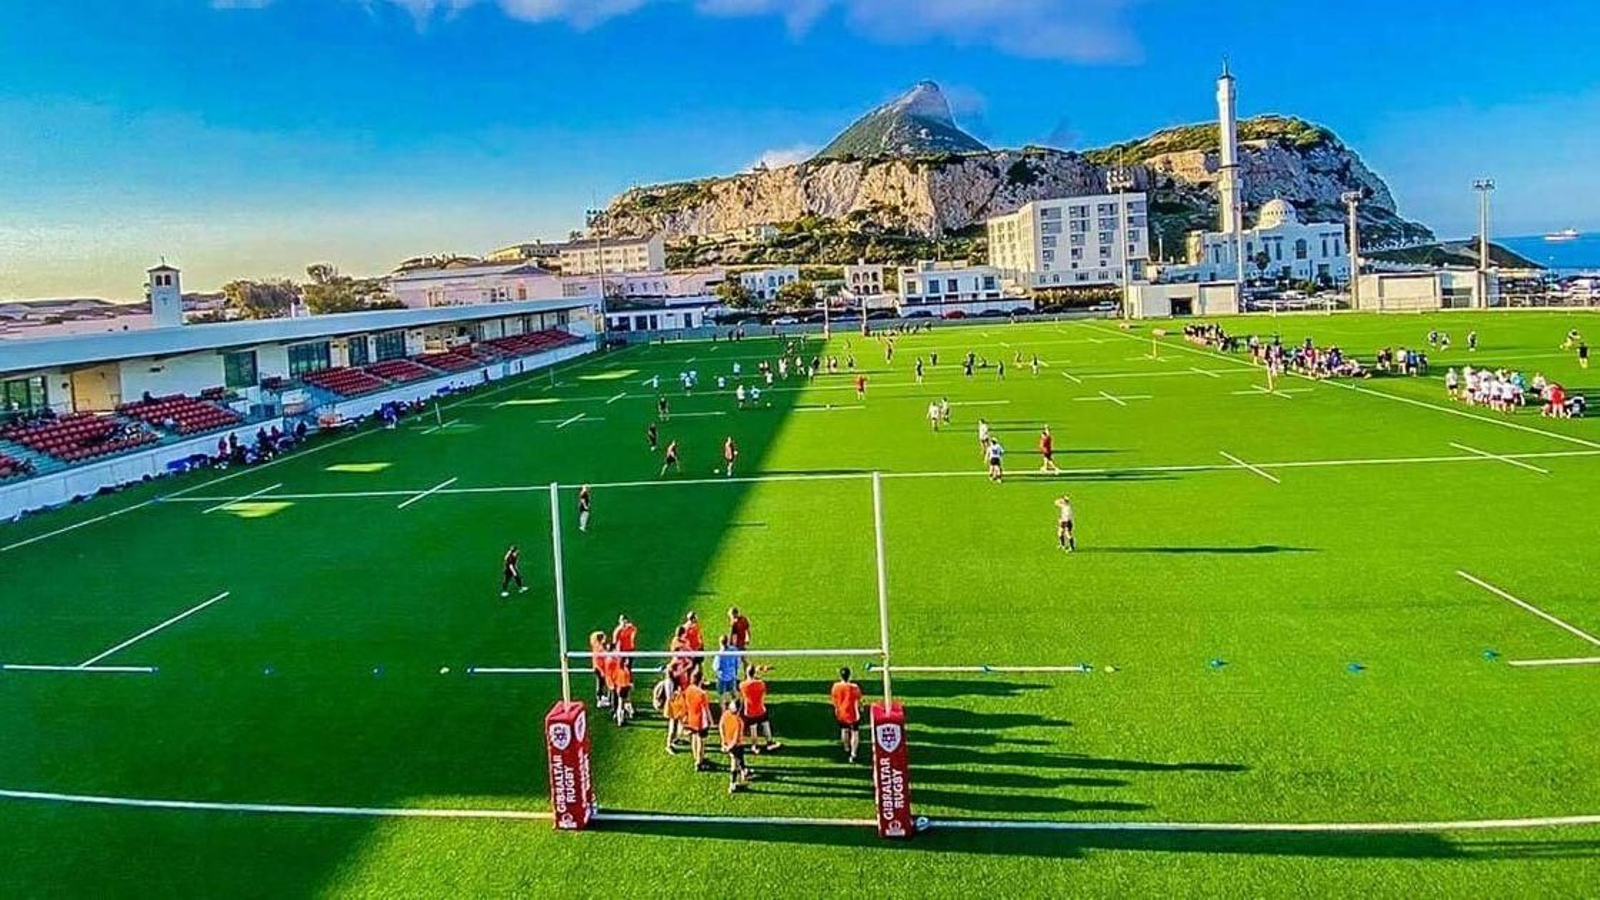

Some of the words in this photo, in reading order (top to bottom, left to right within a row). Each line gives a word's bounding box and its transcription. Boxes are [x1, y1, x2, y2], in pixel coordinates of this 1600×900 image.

[553, 755, 567, 813] GIBRALTAR
[564, 766, 576, 803] RUGBY
[880, 757, 894, 820] GIBRALTAR
[892, 769, 905, 809] RUGBY
